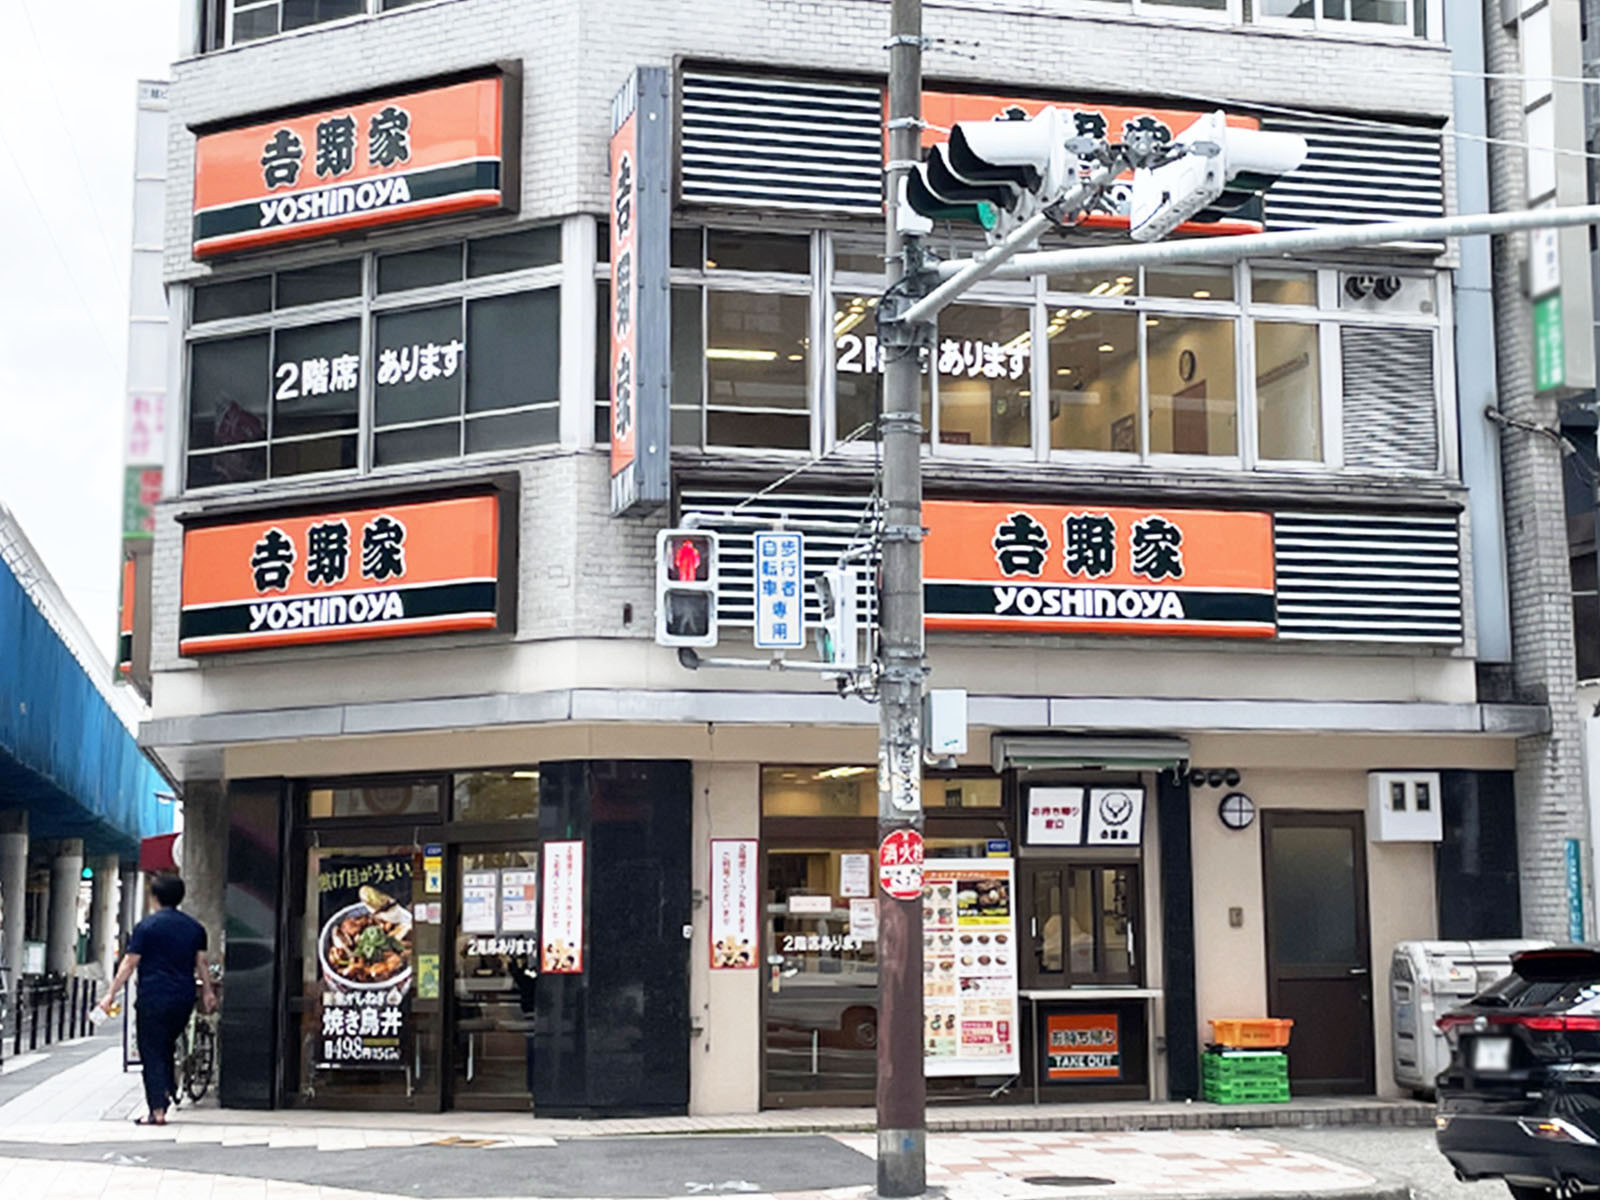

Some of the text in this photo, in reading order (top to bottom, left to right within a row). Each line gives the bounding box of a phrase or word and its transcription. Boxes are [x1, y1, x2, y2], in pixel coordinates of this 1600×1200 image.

[259, 177, 411, 227] YOSHINOYA
[251, 516, 405, 592] 吉野家
[762, 540, 777, 596] 自転車
[781, 540, 796, 597] 歩行者
[992, 512, 1184, 581] 吉野家
[249, 592, 404, 636] YOSHINOYA
[772, 601, 787, 640] 専用
[993, 587, 1184, 618] YOSHINOYA
